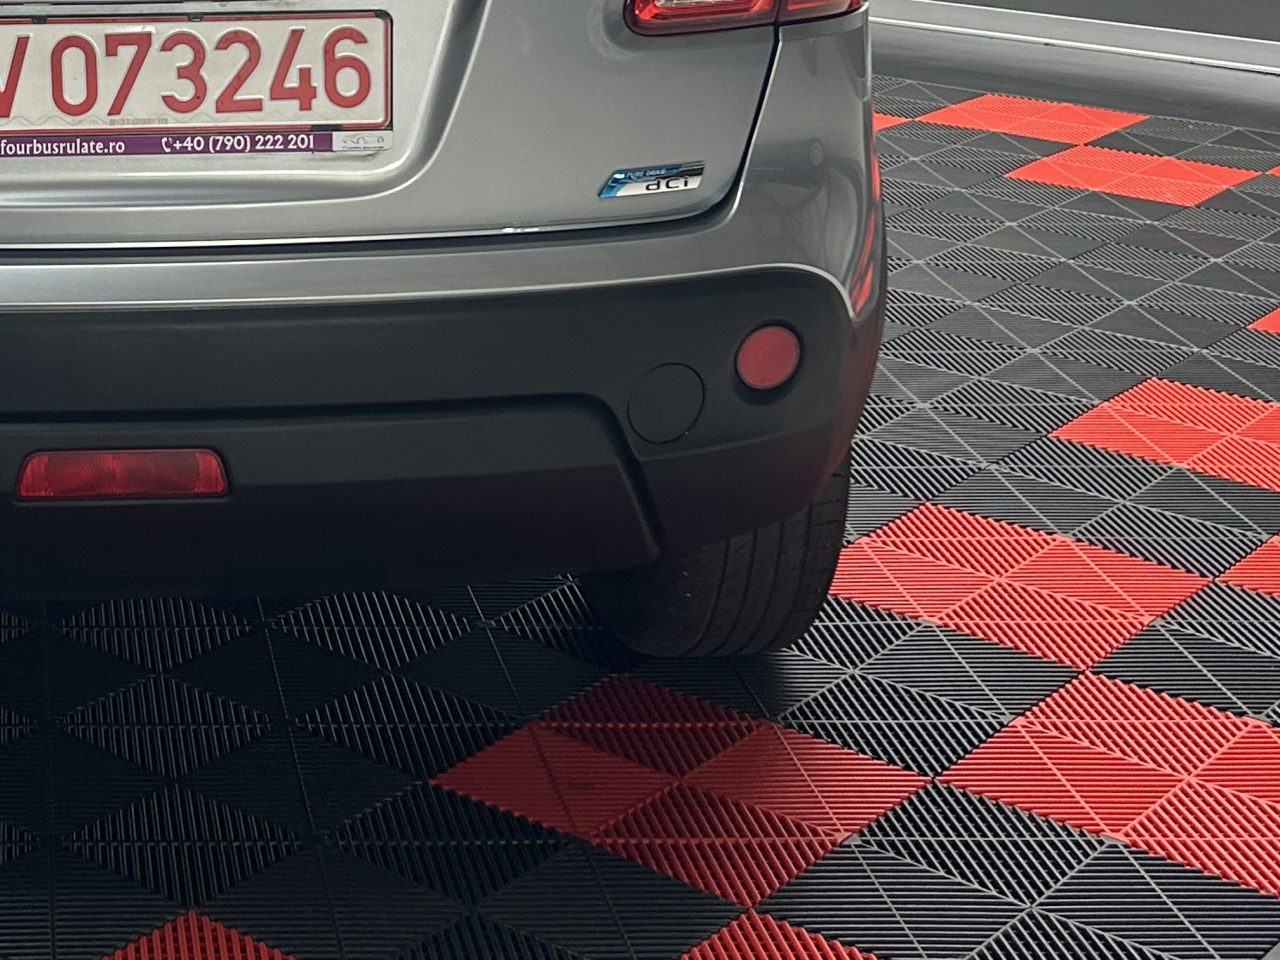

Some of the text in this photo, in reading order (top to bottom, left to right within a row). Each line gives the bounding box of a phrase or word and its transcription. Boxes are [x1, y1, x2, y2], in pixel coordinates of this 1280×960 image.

[50, 25, 372, 117] 073246
[173, 136, 205, 151] +40
[209, 135, 251, 153] (790)
[255, 135, 284, 150] 222
[287, 134, 315, 150] 201
